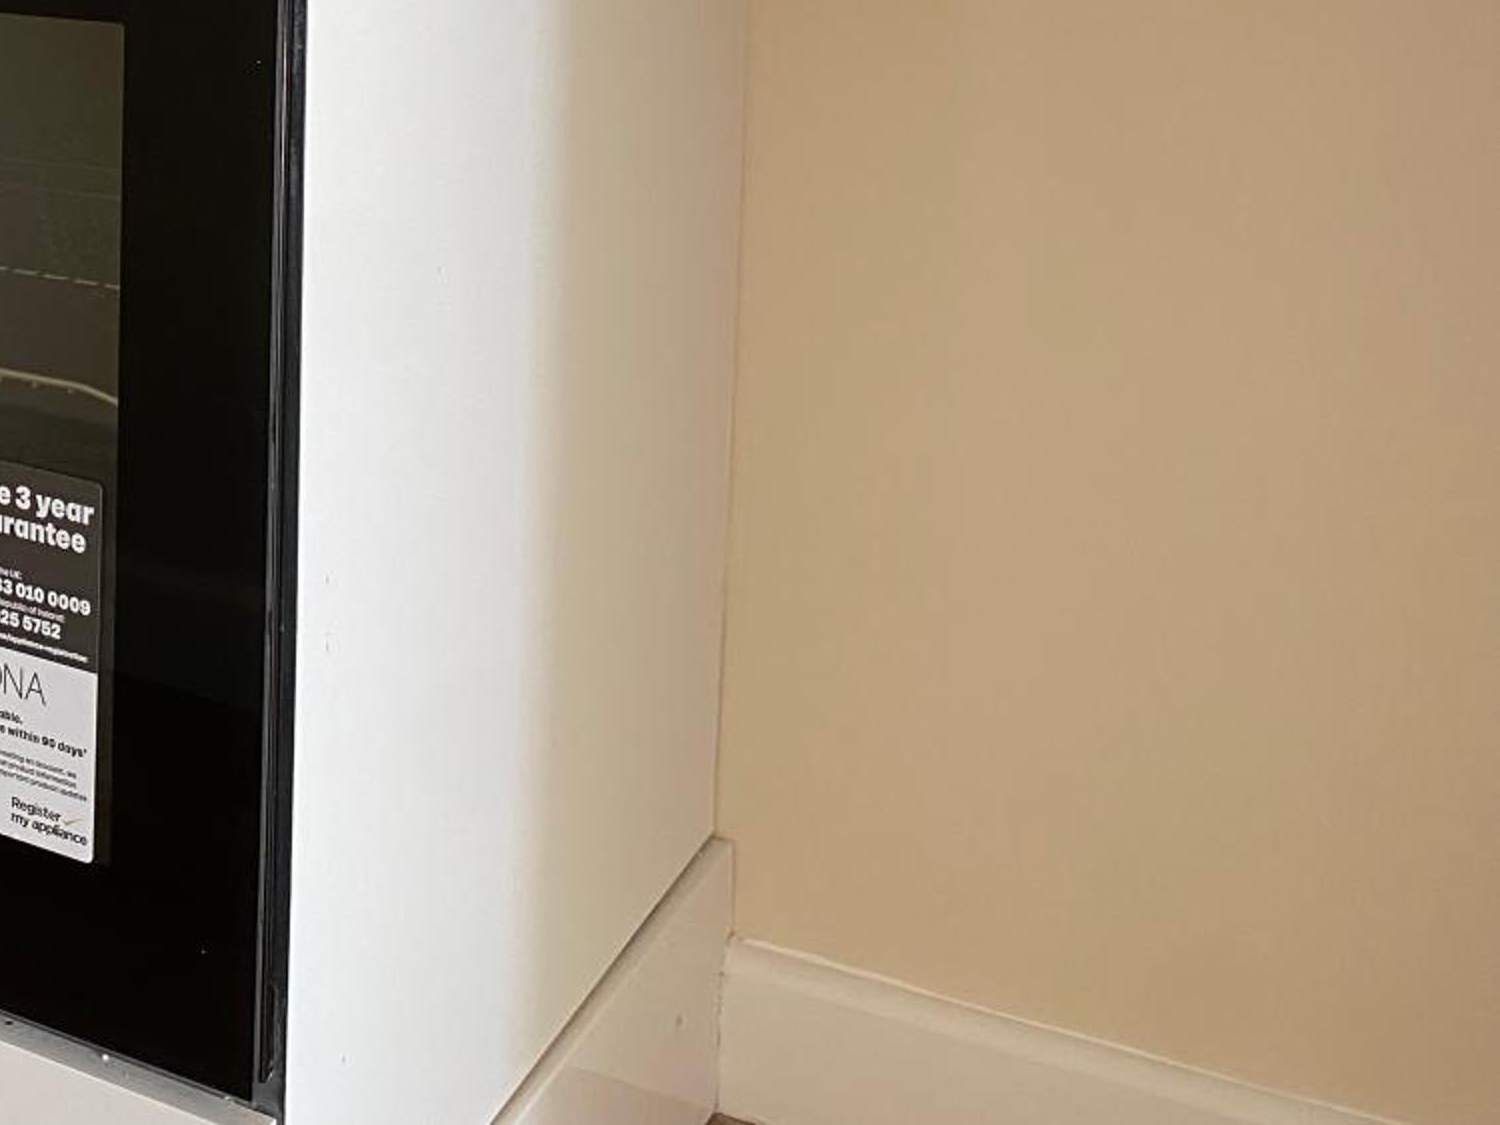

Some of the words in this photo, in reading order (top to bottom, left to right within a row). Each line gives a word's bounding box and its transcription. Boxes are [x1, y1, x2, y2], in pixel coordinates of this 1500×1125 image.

[15, 485, 31, 510] 3
[34, 493, 95, 525] year
[15, 582, 44, 604] 010
[47, 590, 91, 616] 0009
[22, 614, 61, 640] 5752
[7, 726, 40, 744] within
[41, 735, 56, 749] 90
[11, 796, 61, 823] Register
[10, 813, 29, 829] my
[31, 819, 88, 846] appliance
